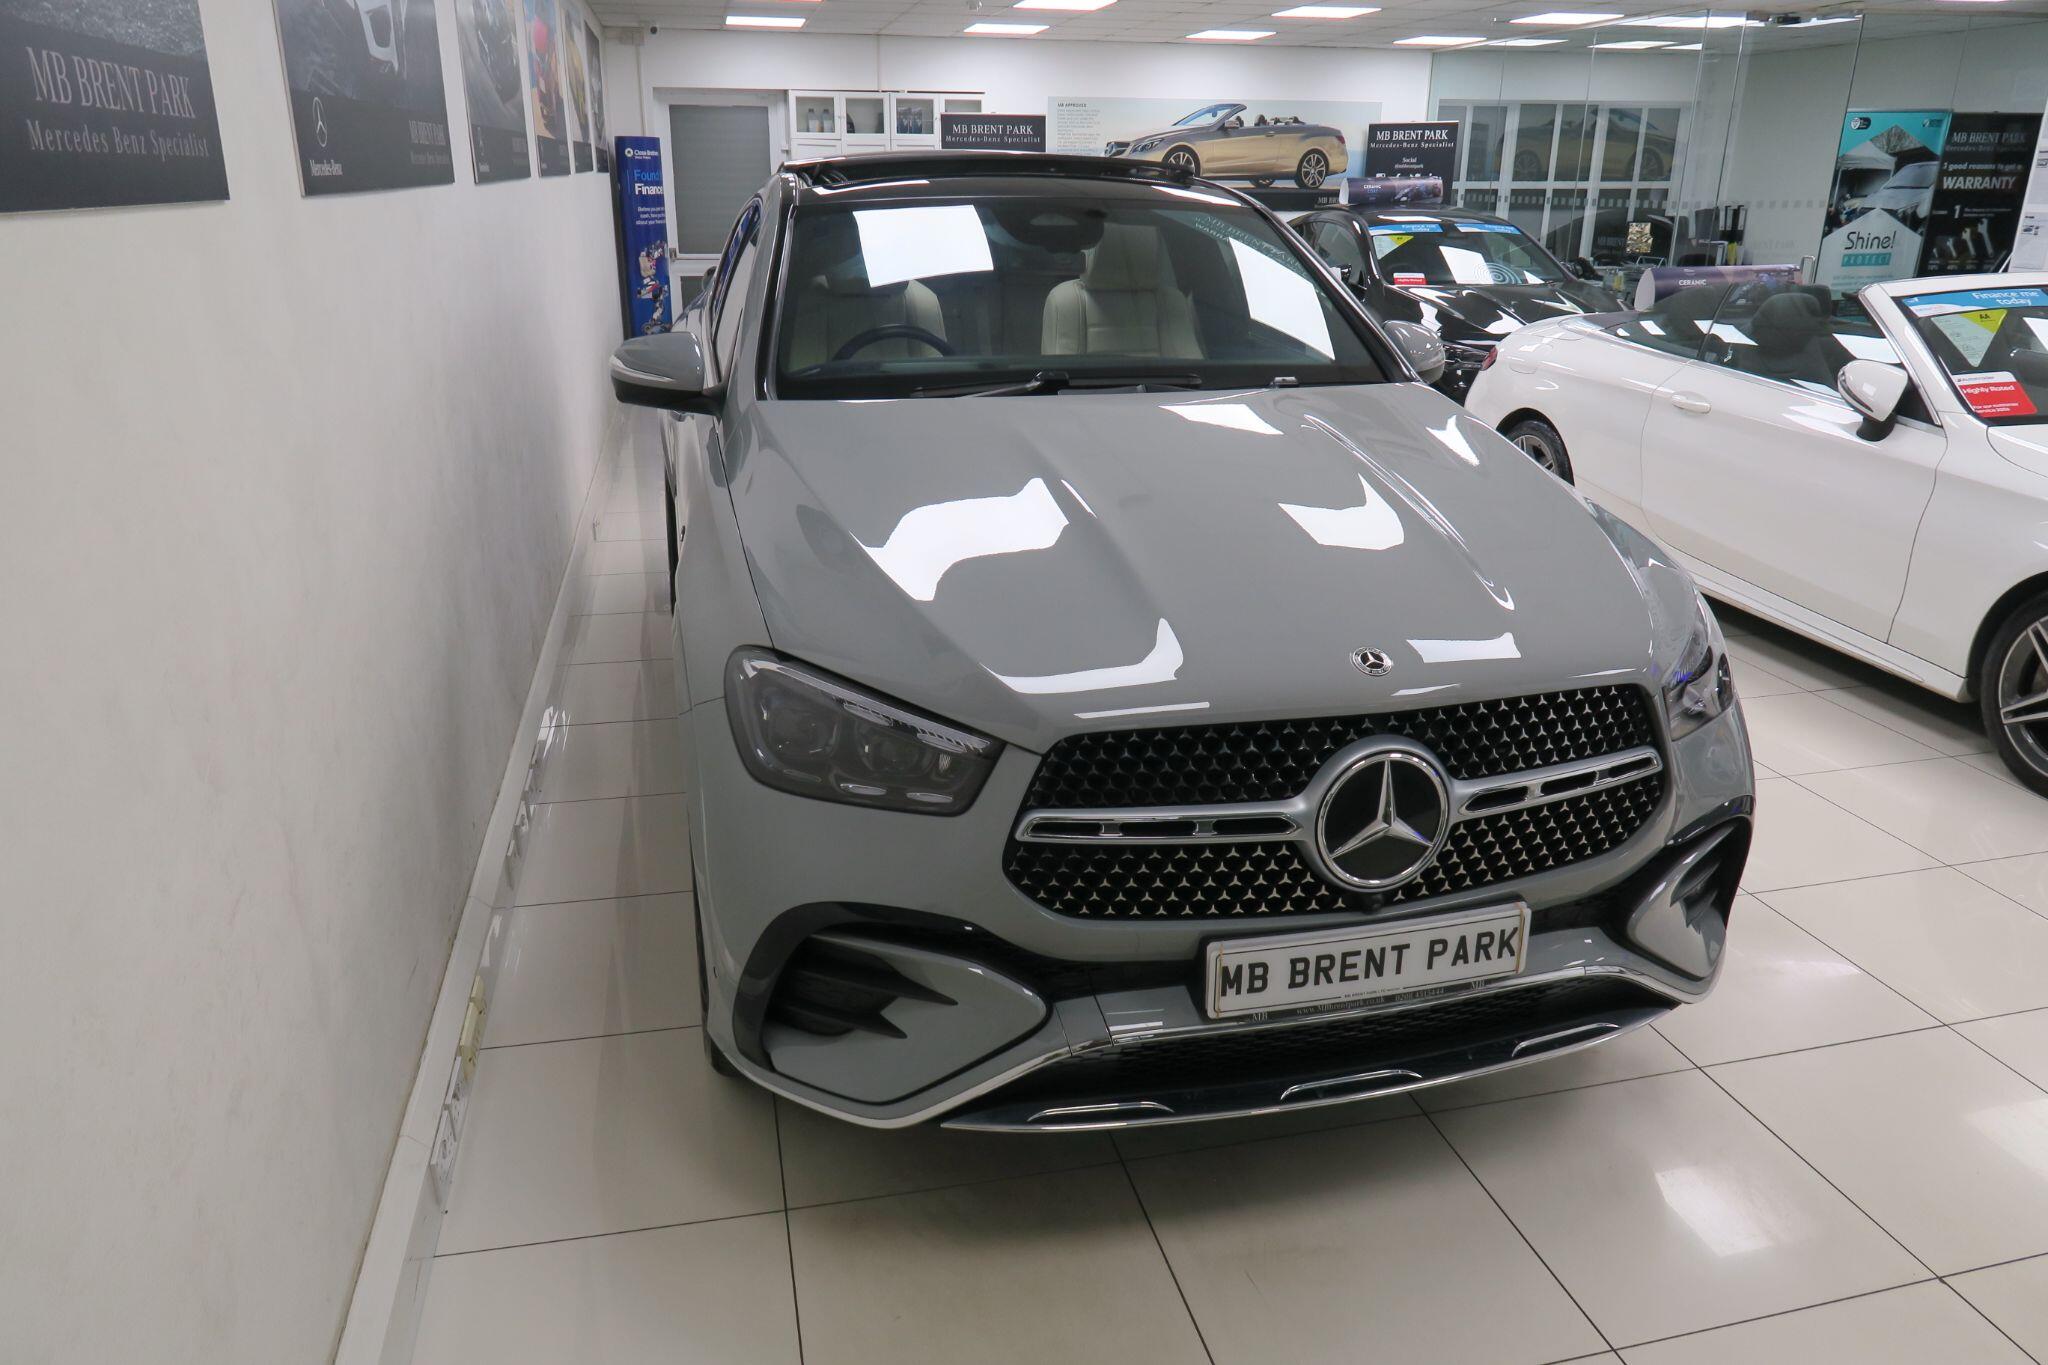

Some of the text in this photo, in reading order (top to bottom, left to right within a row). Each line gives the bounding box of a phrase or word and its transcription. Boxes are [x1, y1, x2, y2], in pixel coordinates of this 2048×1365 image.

[25, 46, 196, 119] MB BRENT PARK
[952, 124, 1033, 135] MB BRENT PARK
[1376, 129, 1448, 141] MB BRENT PARK
[27, 119, 209, 162] Mercedes Benz Specialist
[1004, 135, 1040, 144] Specialist
[1951, 132, 2025, 144] MB BRENT PARK
[1420, 141, 1454, 149] Specialist
[1948, 162, 1968, 171] good
[1943, 176, 2016, 189] WARRANTY
[1954, 205, 1960, 218] 1
[1844, 230, 1897, 250] Shine!
[1844, 254, 1889, 264] PROTECT
[1972, 290, 2040, 300] Finance me
[1996, 298, 2032, 306] today
[1962, 384, 2015, 394] Highly Rated
[1220, 927, 1519, 997] MB BRENT PARK
[1471, 979, 1486, 990] MB
[1252, 1012, 1268, 1022] MB
